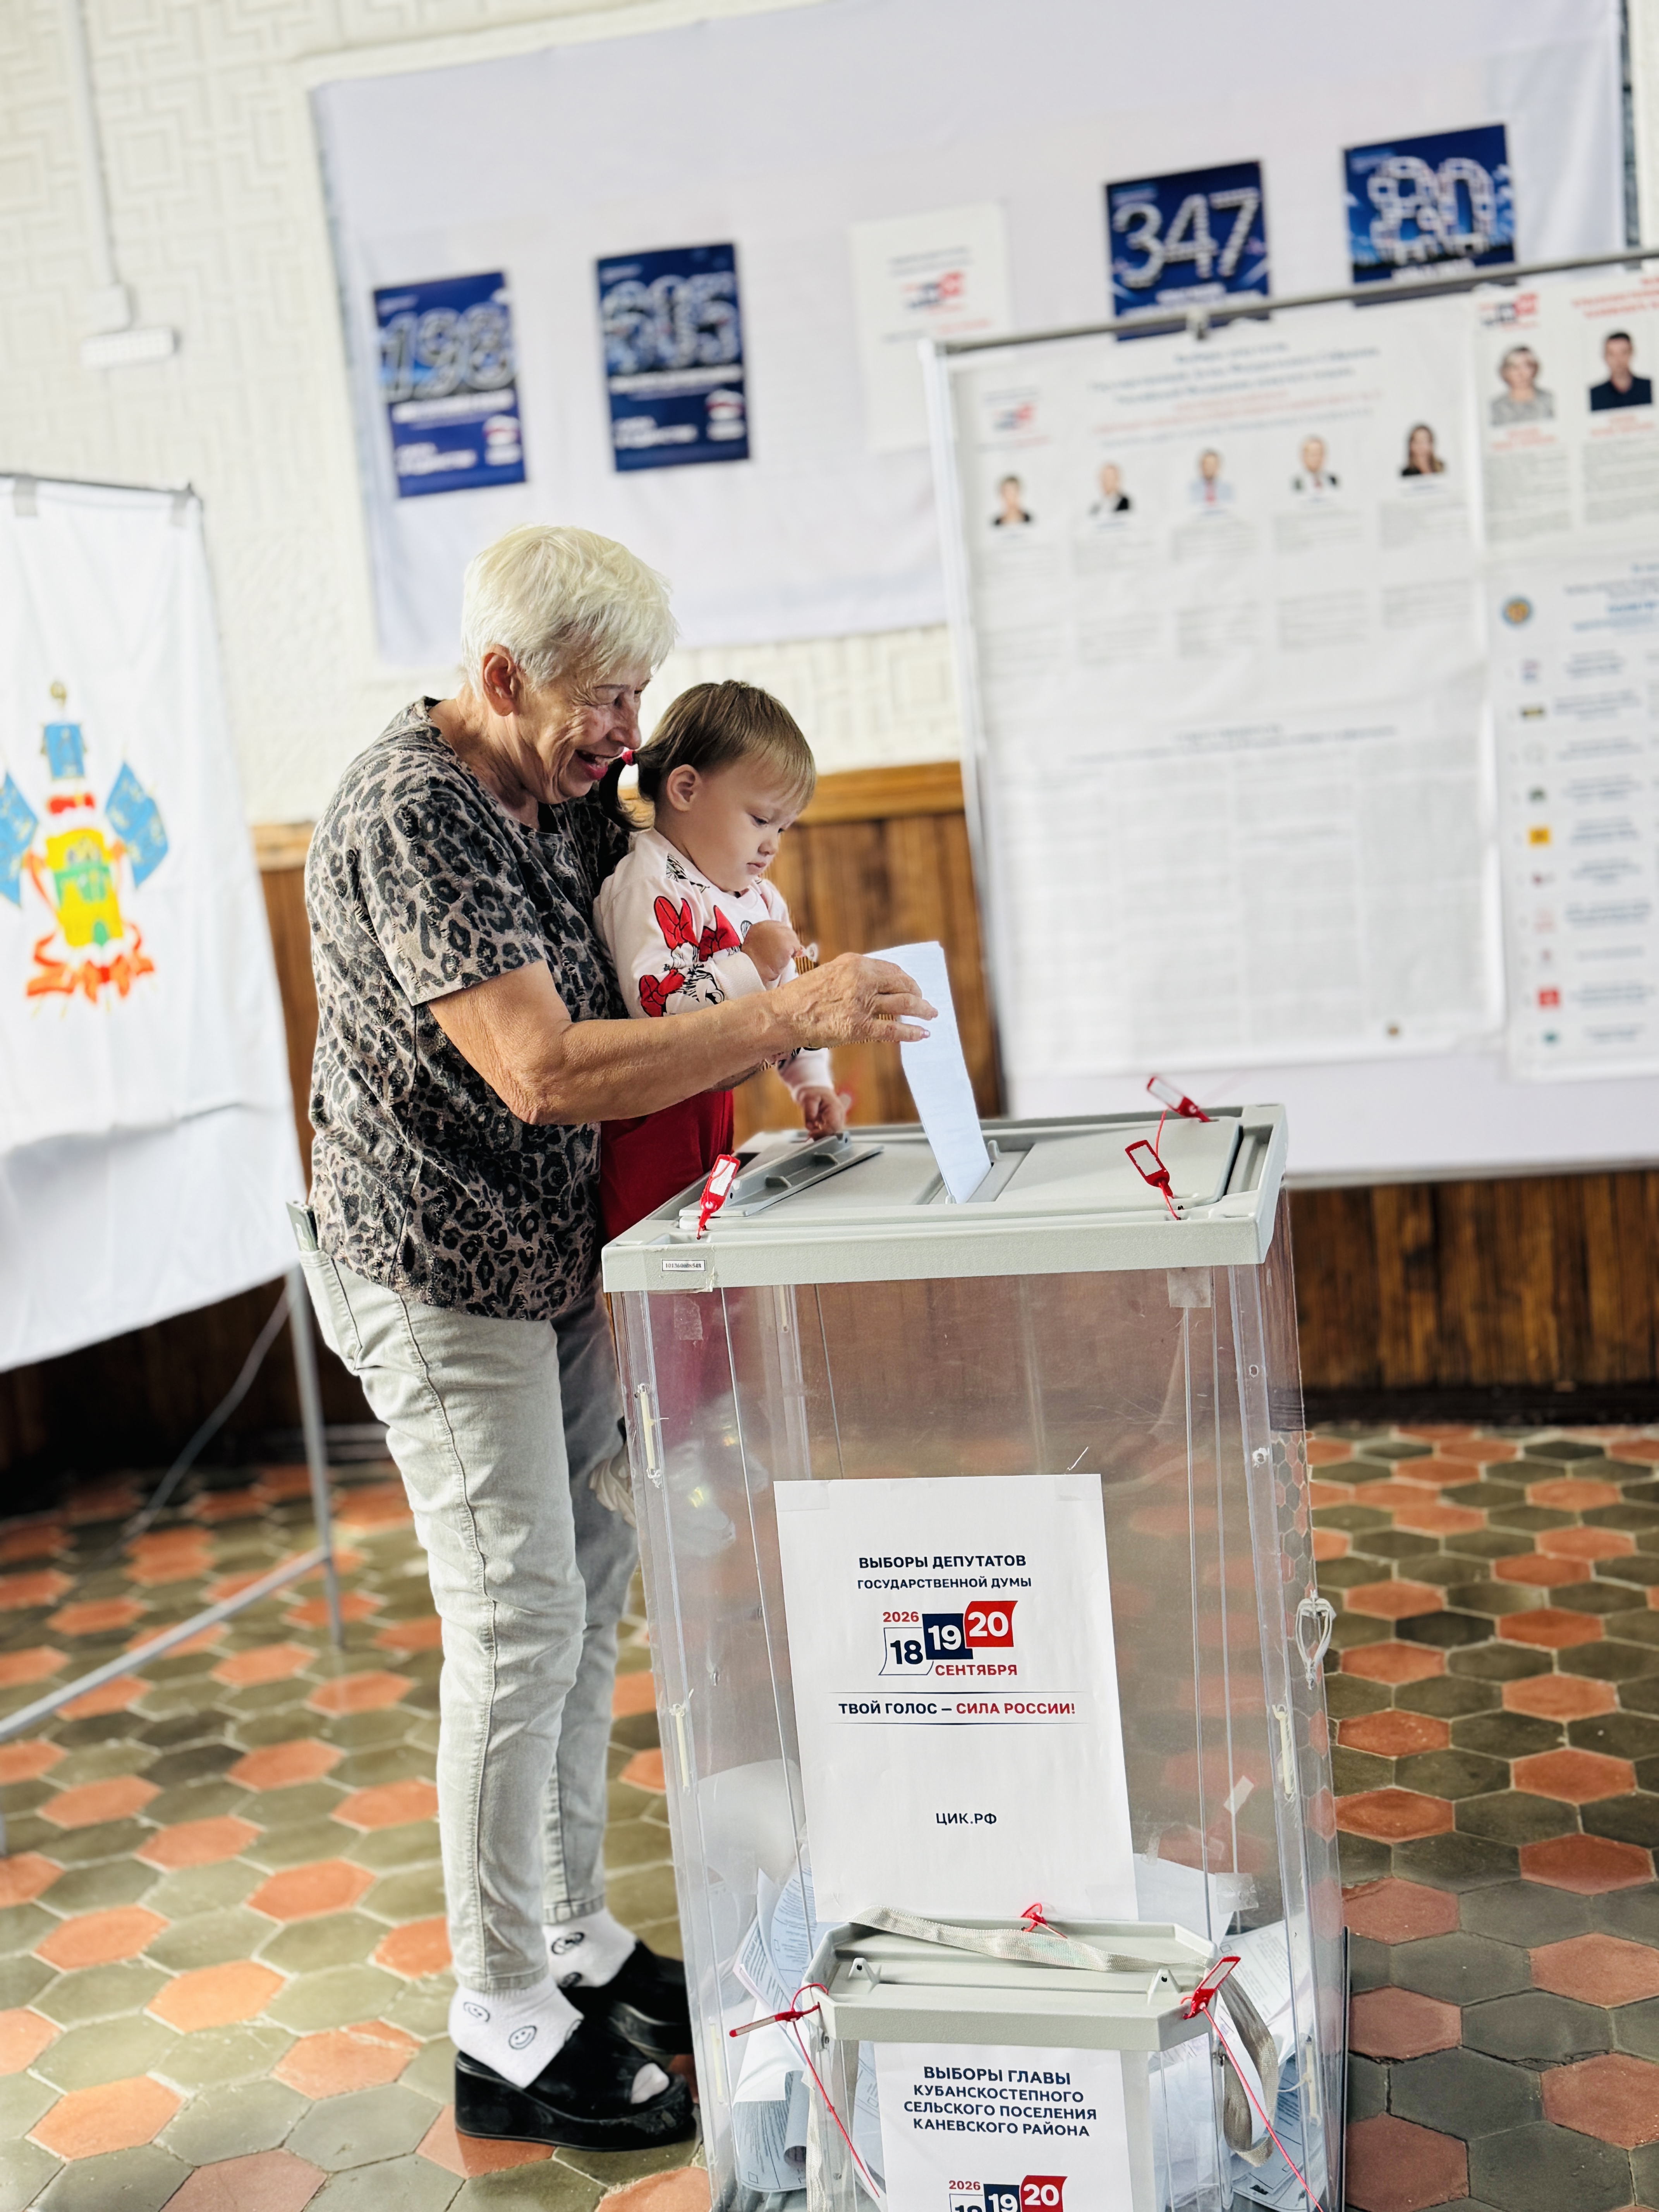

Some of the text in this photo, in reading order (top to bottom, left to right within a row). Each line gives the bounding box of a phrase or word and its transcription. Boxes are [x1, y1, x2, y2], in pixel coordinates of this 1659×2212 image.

[1113, 187, 1259, 289] 347
[859, 1555, 1026, 1569] ВЫБОРЫ ДЕПУТАТОВ
[858, 1576, 1031, 1590] ГОСУДАРСТВЕННОЙ ДУМЫ
[883, 1612, 919, 1622] 2026
[890, 1612, 1008, 1664] 18 19 20
[936, 1665, 1017, 1676] СЕНТЯБРЯ
[838, 1700, 881, 1714] ТВОЙ
[885, 1703, 937, 1714] ГОЛОС
[957, 1703, 1000, 1714] СИЛА
[1004, 1703, 1075, 1714] РОССИИ!
[936, 1813, 996, 1825] ЦИК.РФ
[924, 2066, 1070, 2085] ВЫБОРЫ ГЛАВЫ
[914, 2085, 1083, 2102] КУБАНСКОСТЕПНОГО
[904, 2101, 1096, 2119] СЕЛЬСКОГО ПОСЕЛЕНИЯ
[914, 2118, 1089, 2136] КАНЕВСКОГО РАЙОНА
[949, 2181, 980, 2190] 2026
[988, 2184, 1059, 2212] 19 20
